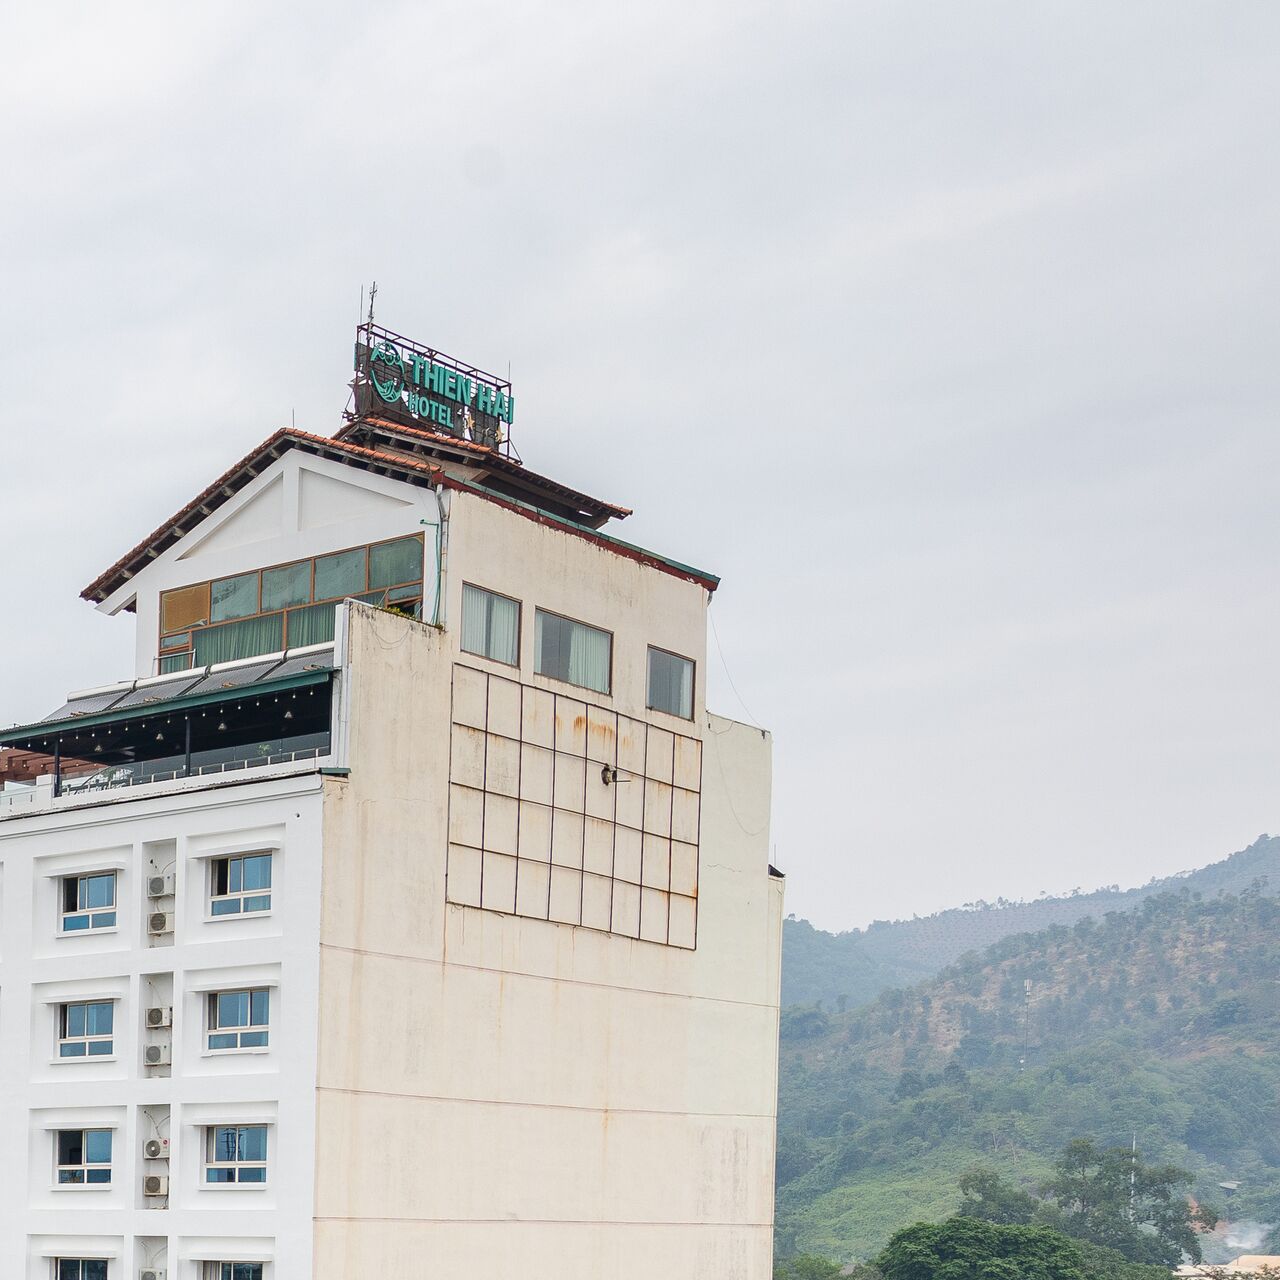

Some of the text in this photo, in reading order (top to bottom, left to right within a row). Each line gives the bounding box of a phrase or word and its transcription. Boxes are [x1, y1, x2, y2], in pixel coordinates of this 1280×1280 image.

[407, 392, 454, 429] HOTEL
[409, 353, 515, 425] THIEN HAI
